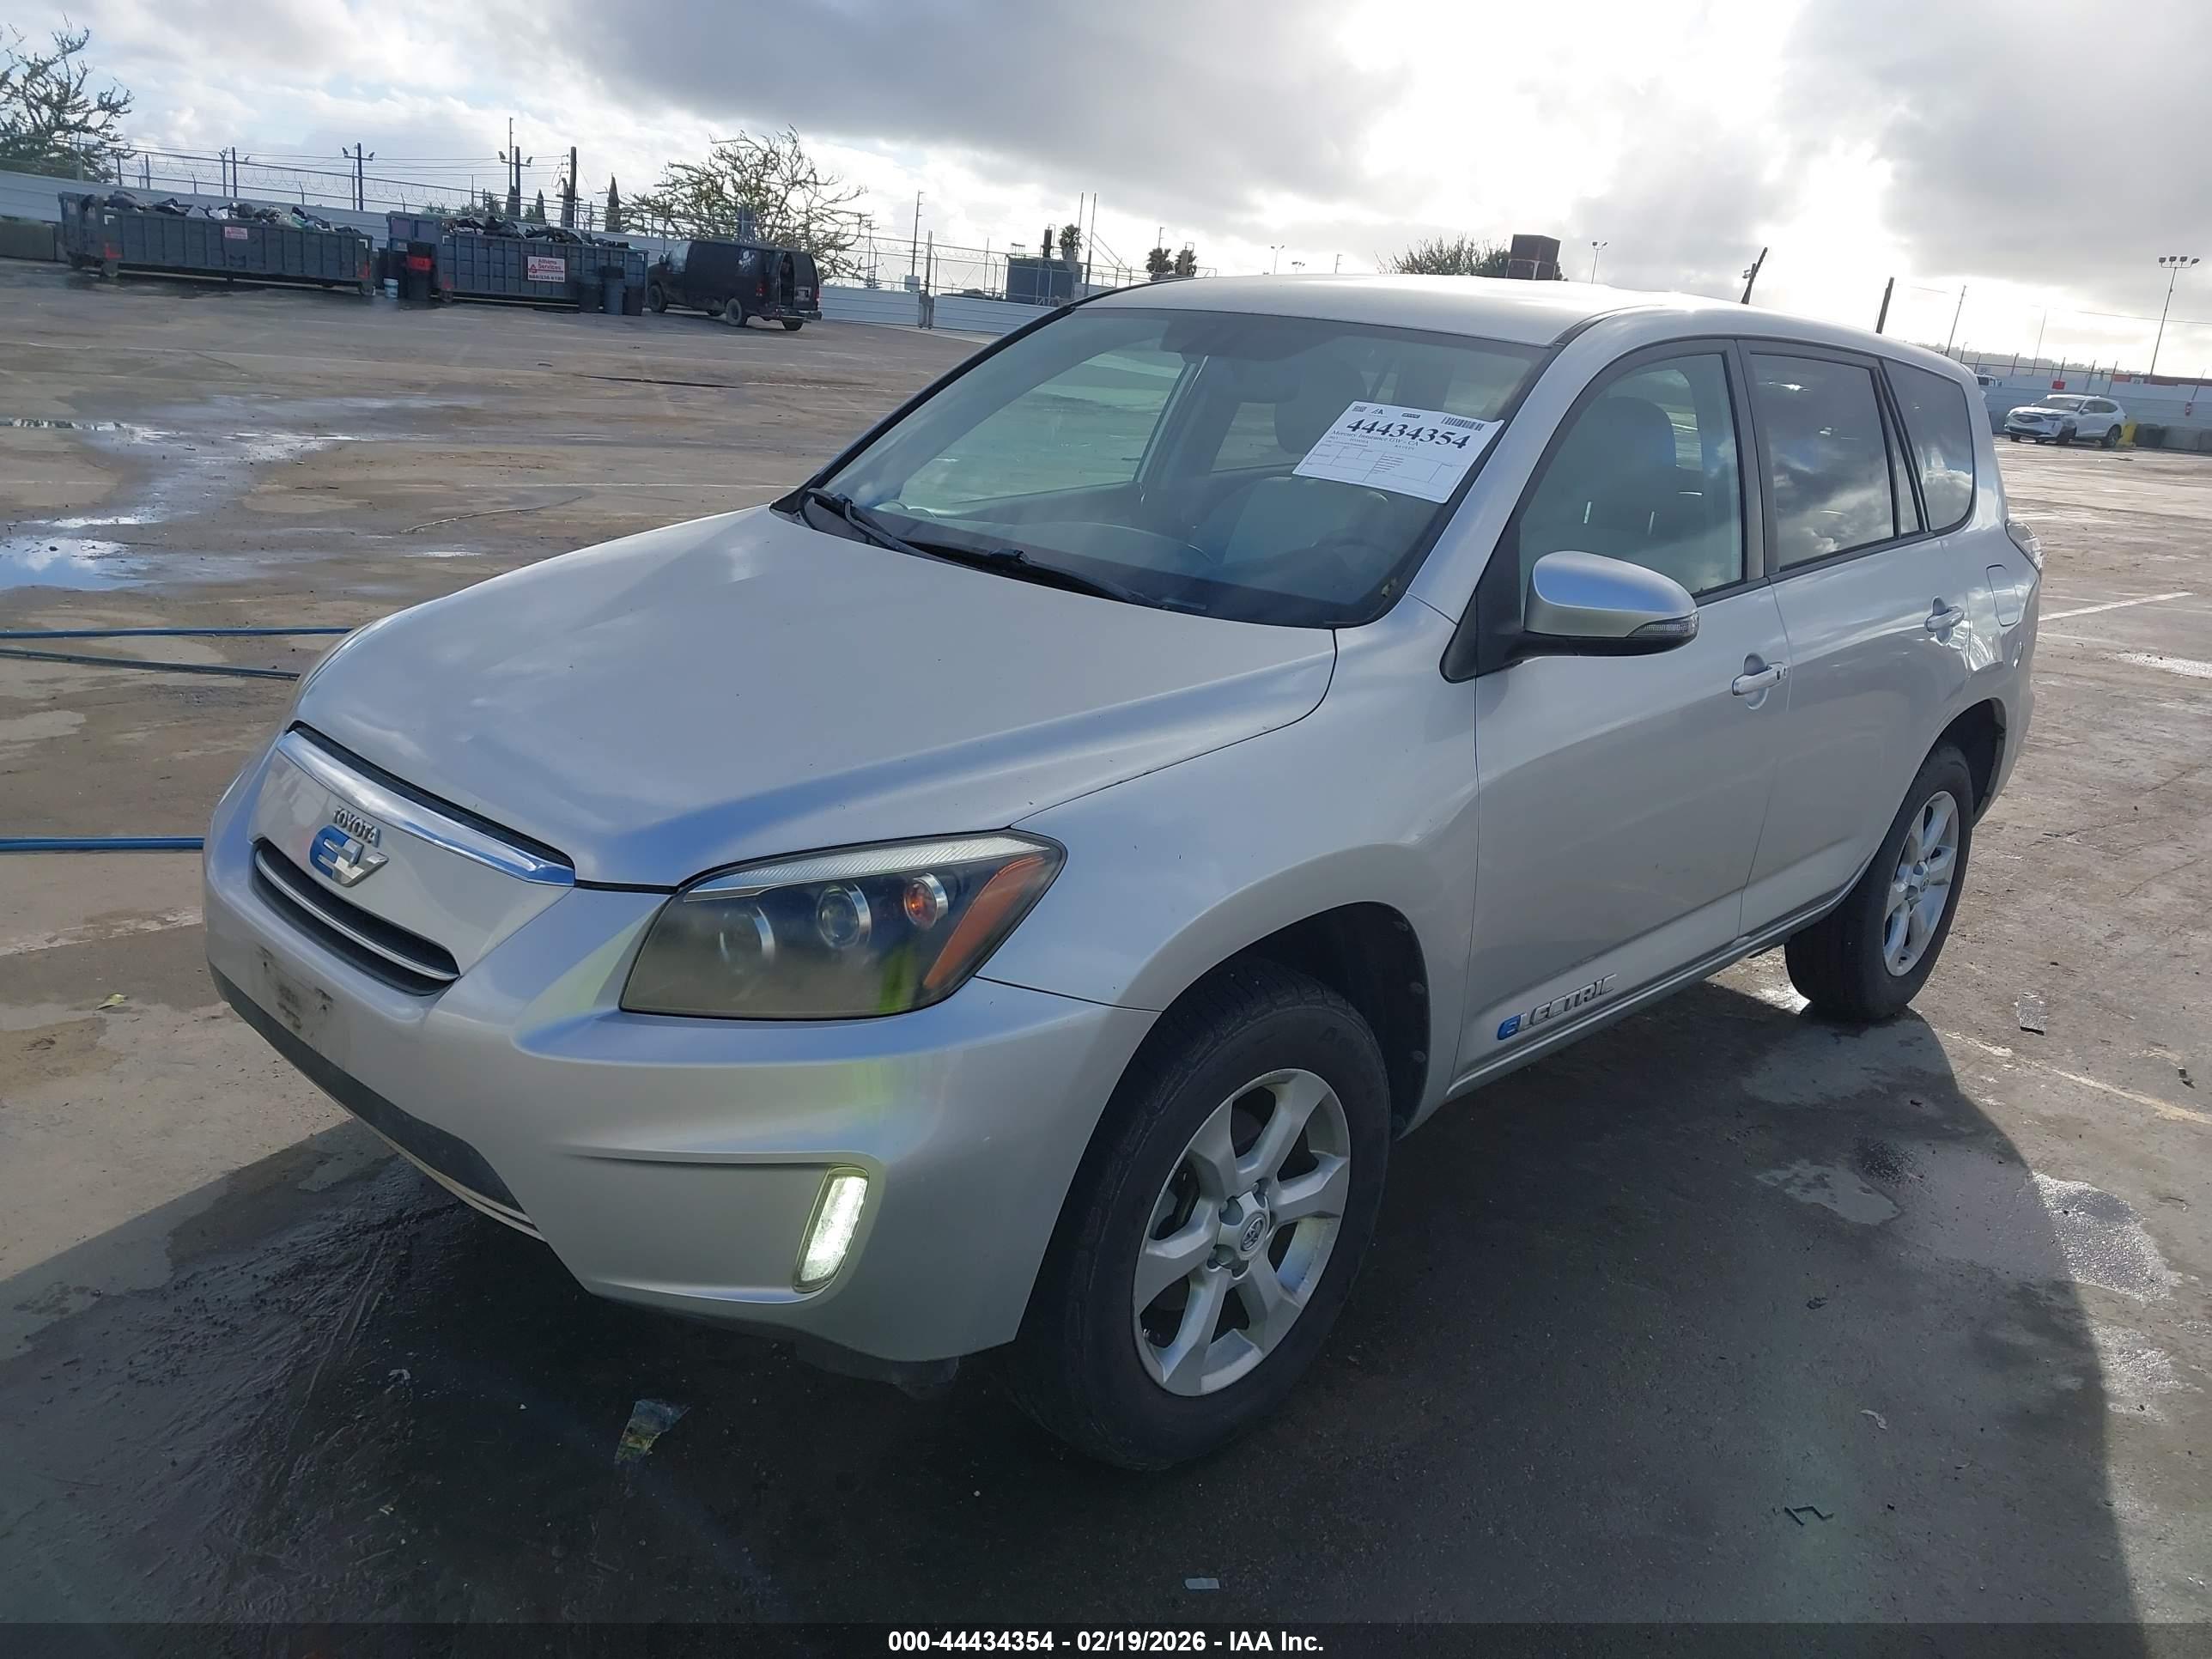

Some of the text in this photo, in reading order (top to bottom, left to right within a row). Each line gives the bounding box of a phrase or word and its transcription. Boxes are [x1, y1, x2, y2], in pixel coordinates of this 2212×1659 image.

[1346, 418, 1471, 449] 44434354
[1358, 433, 1389, 441] Insurance
[333, 806, 381, 848] TOYOTA
[310, 825, 389, 887] EV
[1497, 974, 1617, 1040] ELECTRIC
